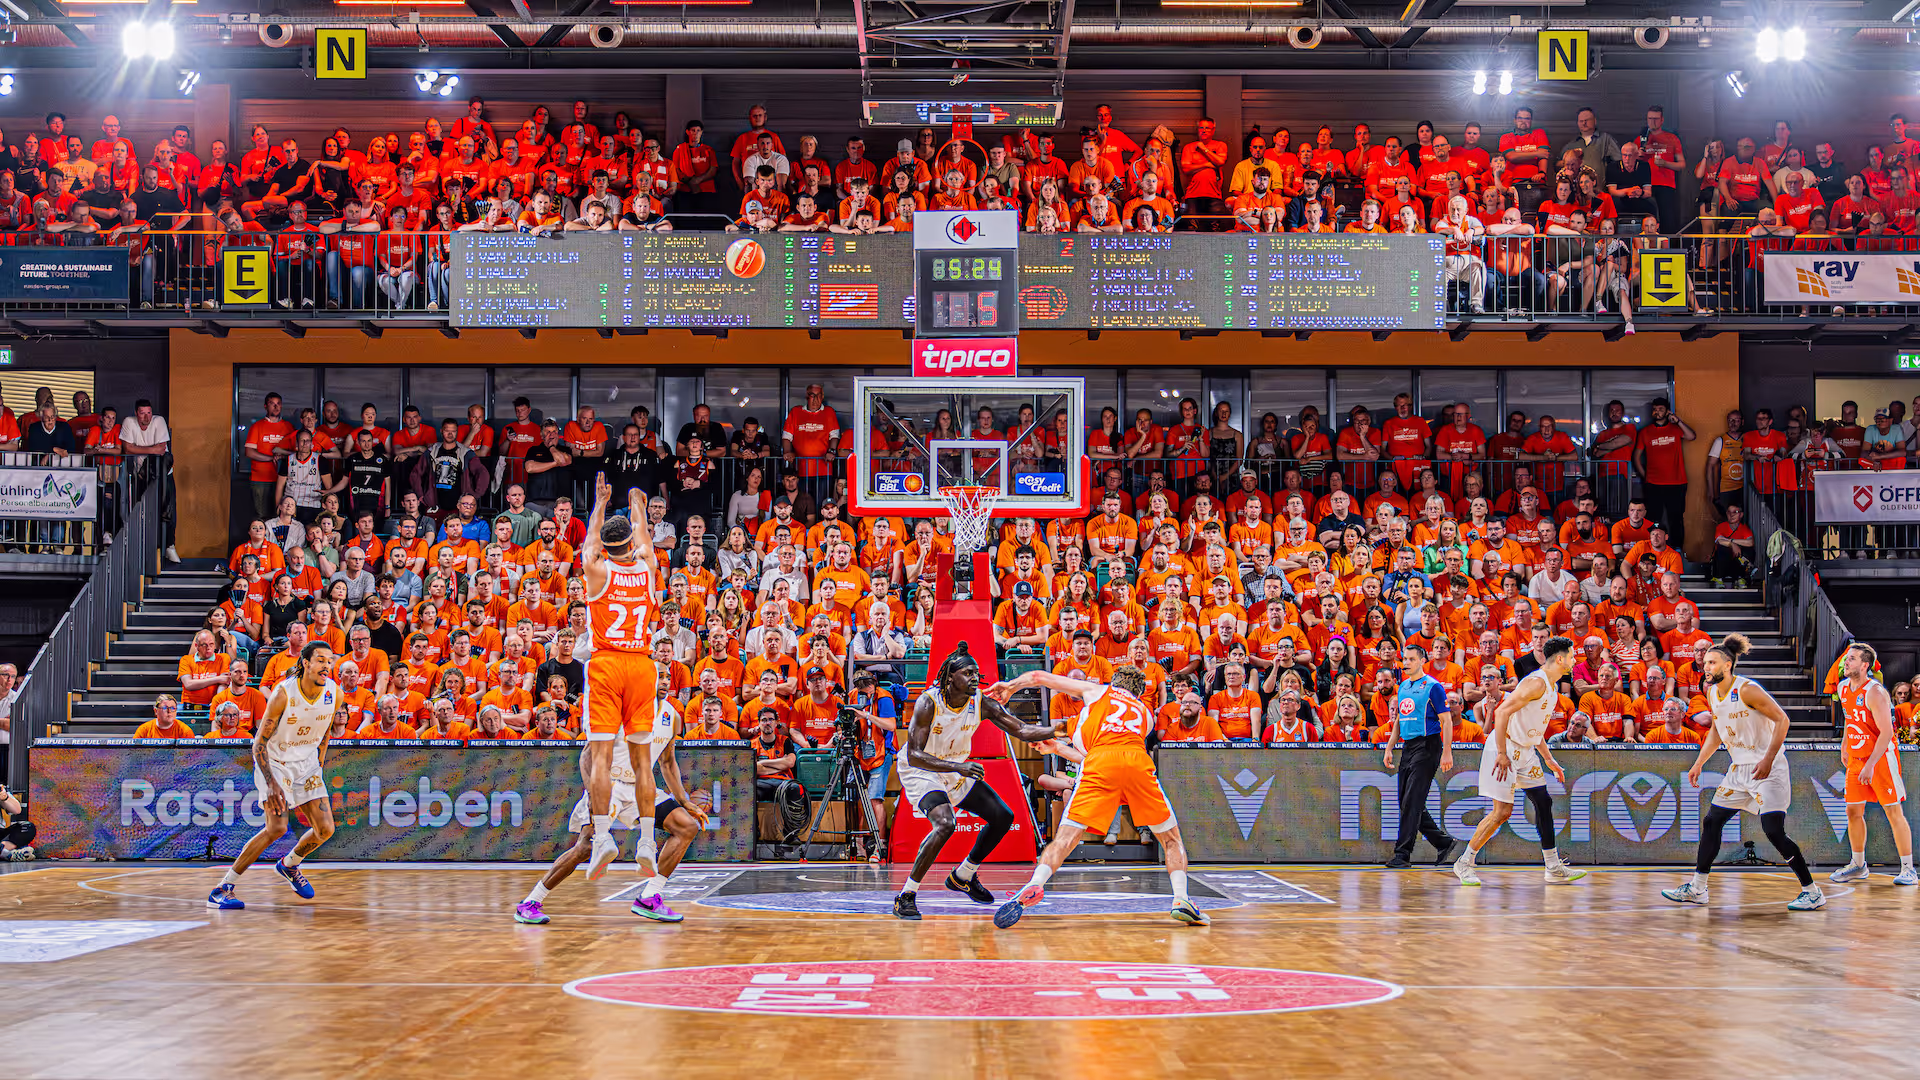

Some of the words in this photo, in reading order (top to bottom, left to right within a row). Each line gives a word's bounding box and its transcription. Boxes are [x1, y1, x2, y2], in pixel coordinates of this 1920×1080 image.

[327, 37, 355, 71] N
[1549, 38, 1577, 72] N
[236, 254, 256, 286] E
[1654, 257, 1673, 289] E
[1814, 260, 1860, 282] ray
[922, 343, 1011, 373] tipico
[879, 483, 900, 491] BBL
[1031, 482, 1062, 493] Credit
[1, 499, 71, 509] Personalberatung
[613, 573, 647, 587] AMINU
[605, 603, 648, 639] 21
[1106, 699, 1143, 734] 22
[1853, 709, 1866, 722] 31
[369, 775, 523, 828] leben
